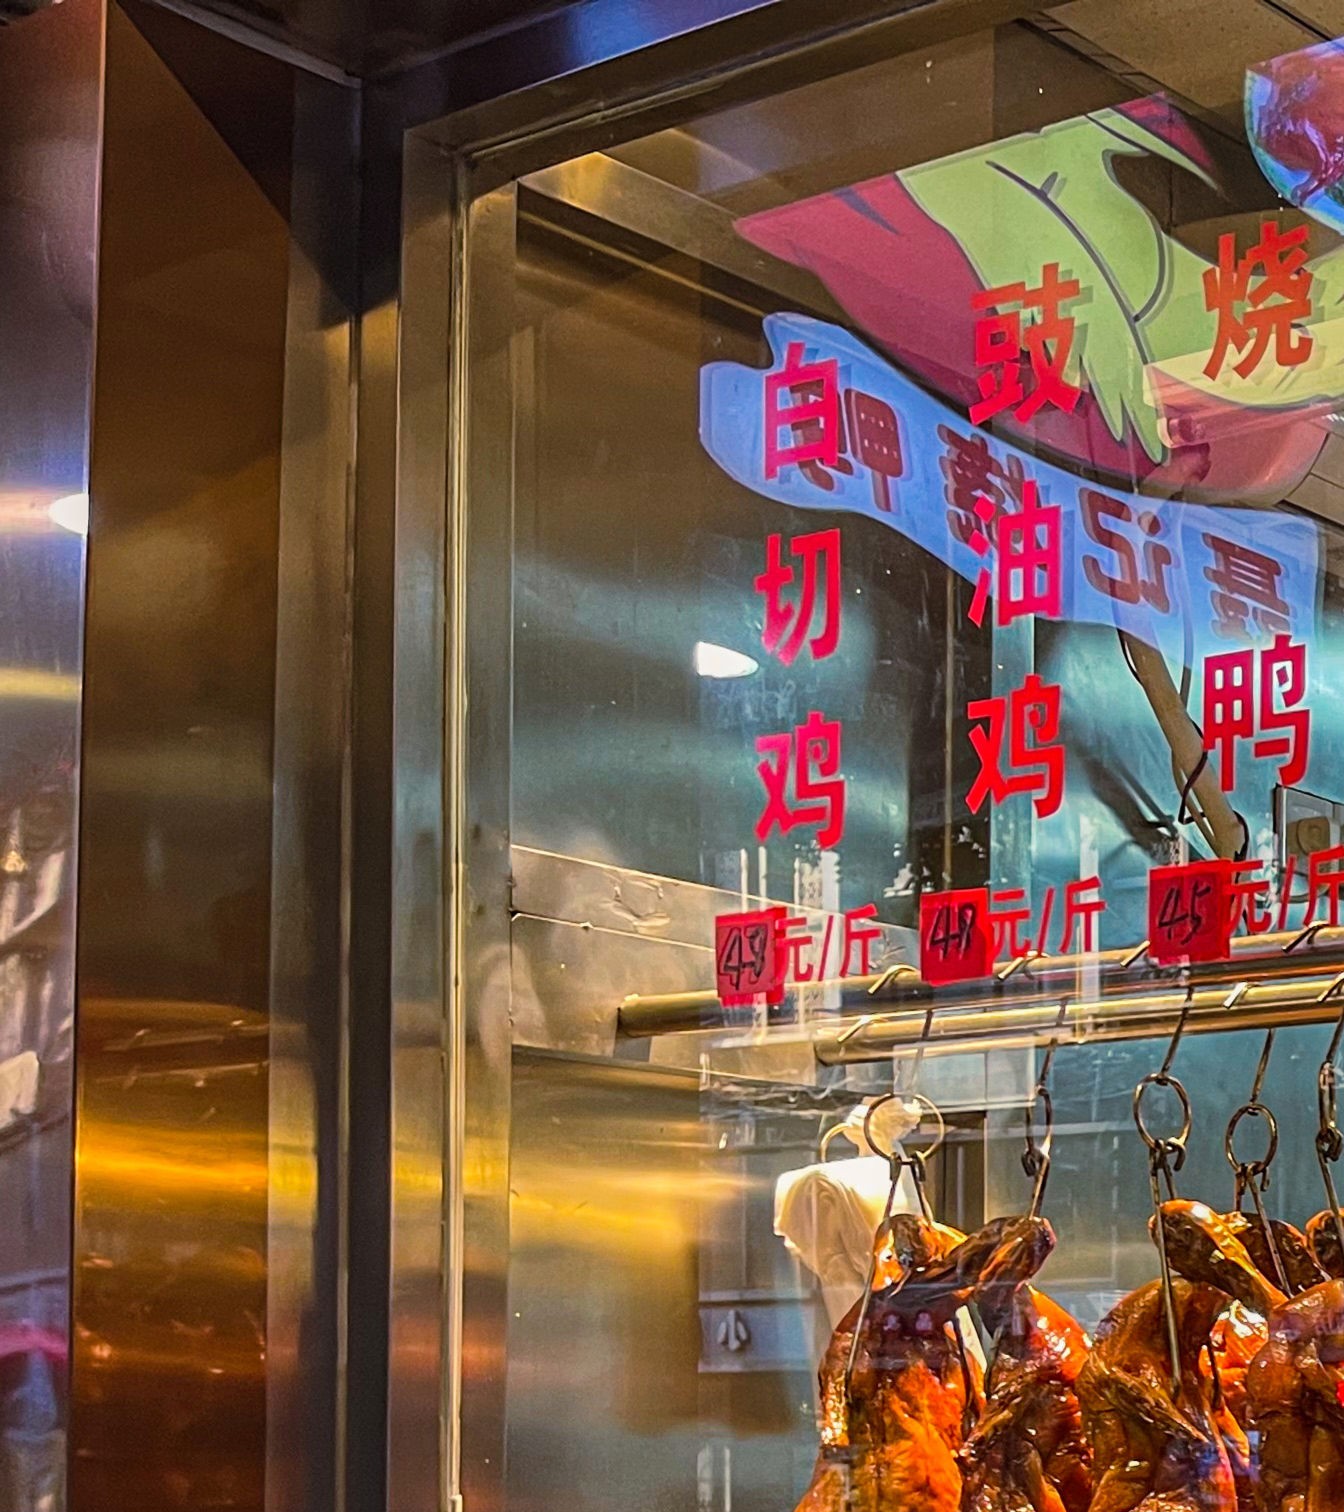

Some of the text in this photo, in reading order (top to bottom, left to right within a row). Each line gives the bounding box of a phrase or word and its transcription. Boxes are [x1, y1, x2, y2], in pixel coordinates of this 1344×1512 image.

[754, 343, 846, 850] 白切鸡
[1203, 222, 1313, 792] 烧鸭
